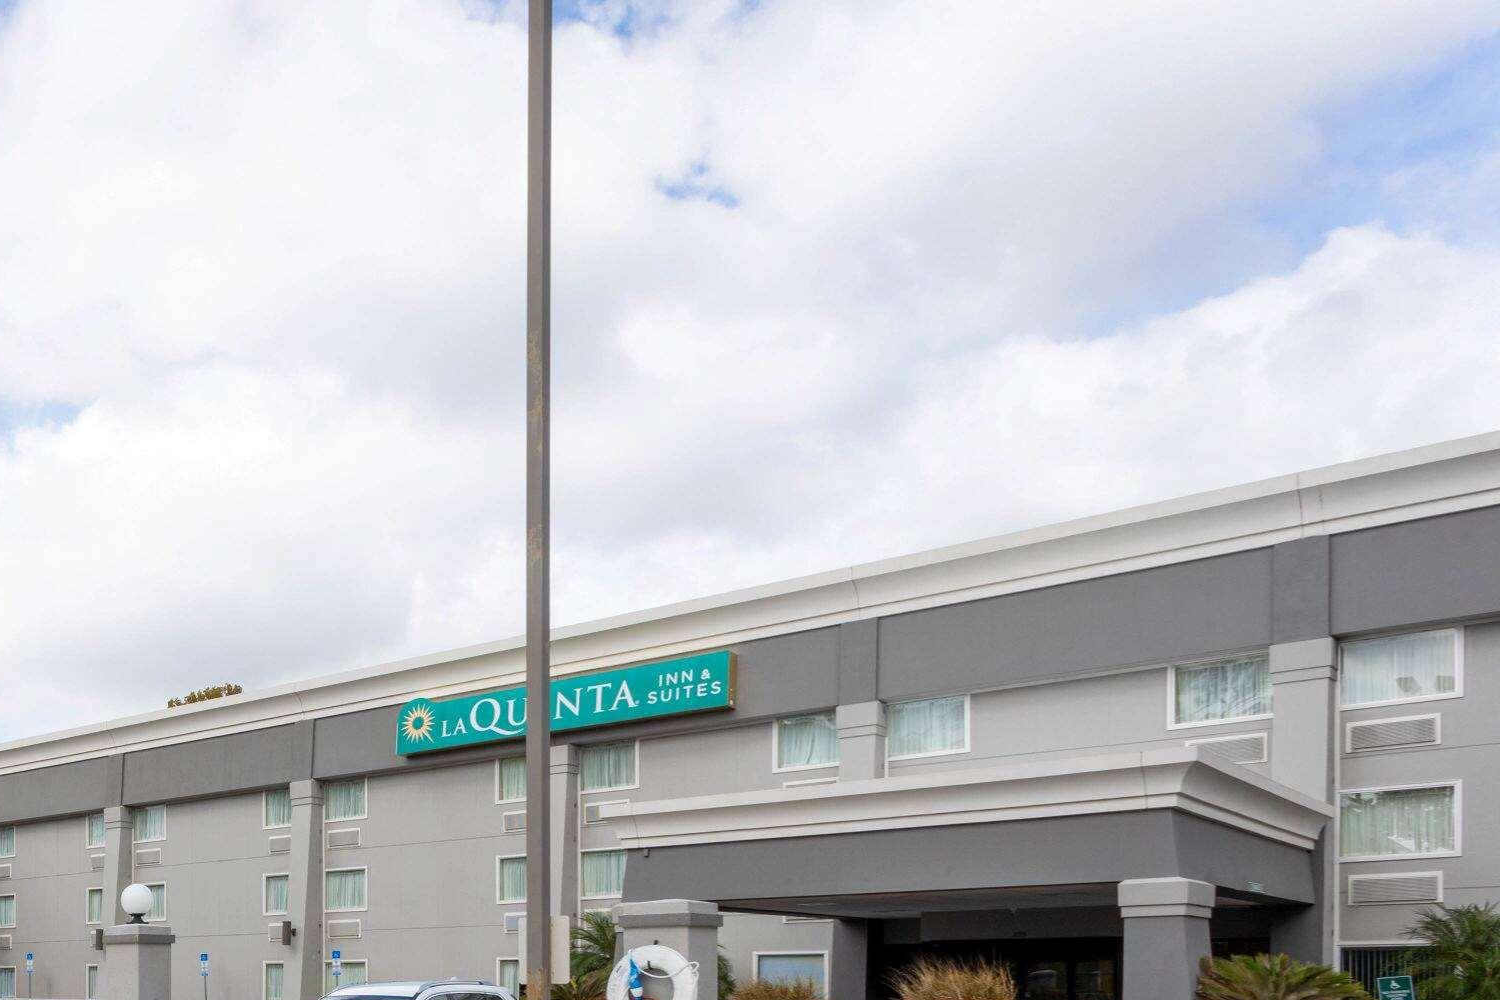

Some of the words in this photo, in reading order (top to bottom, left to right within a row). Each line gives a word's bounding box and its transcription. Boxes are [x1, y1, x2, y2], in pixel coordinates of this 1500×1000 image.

[658, 669, 694, 687] INN
[700, 668, 711, 680] &
[647, 680, 722, 705] SUITES
[441, 718, 468, 738] LA
[469, 679, 639, 736] QUNTA
